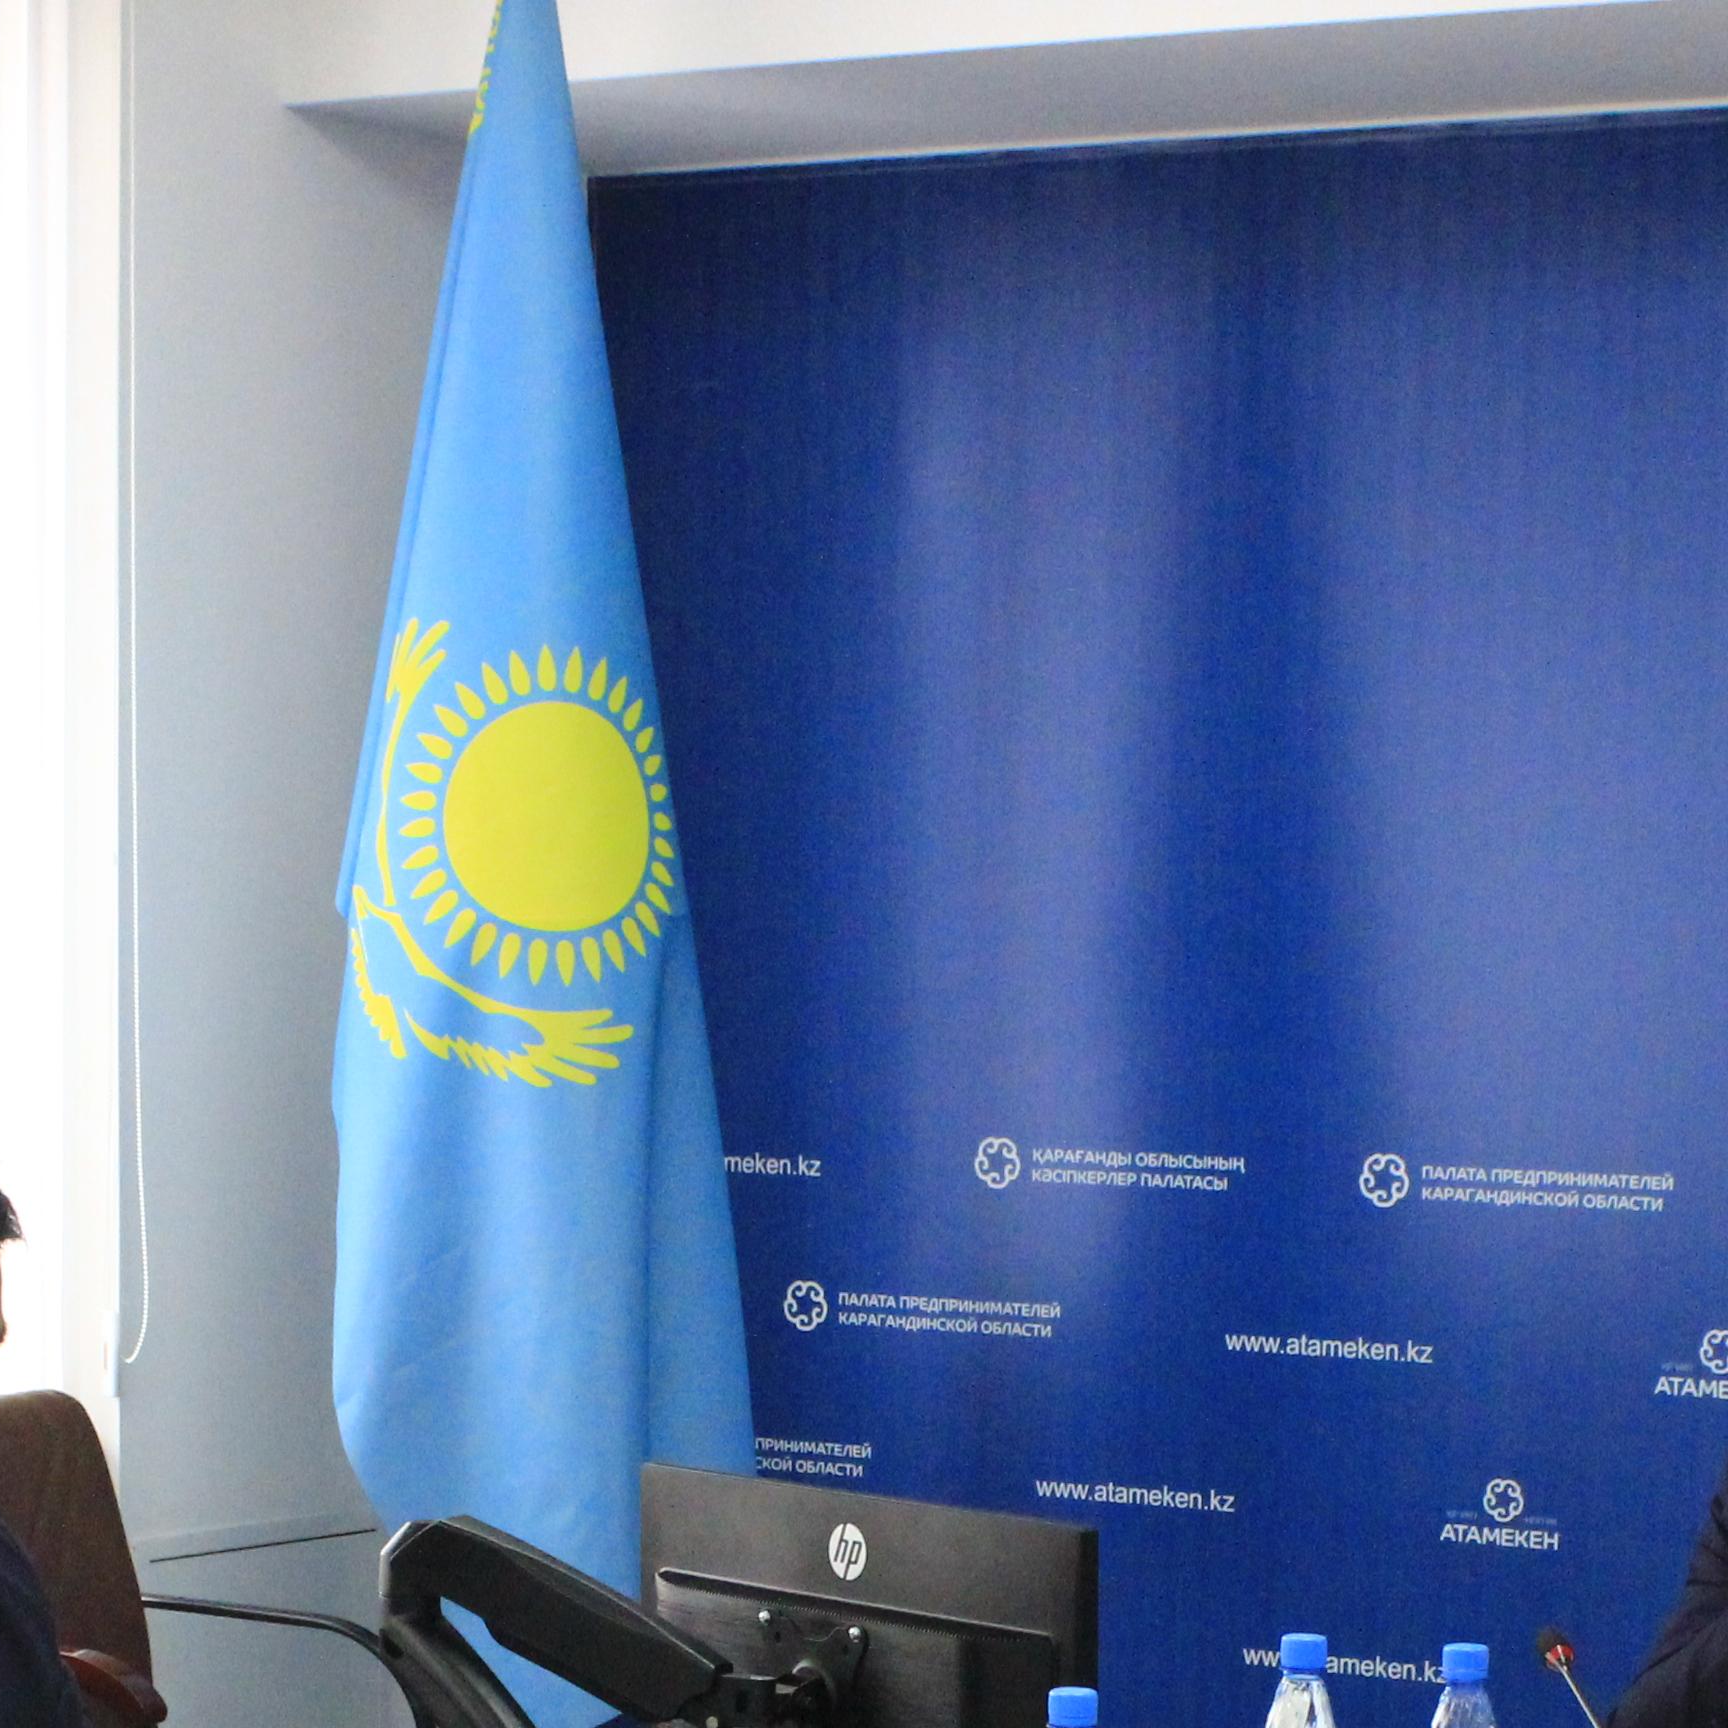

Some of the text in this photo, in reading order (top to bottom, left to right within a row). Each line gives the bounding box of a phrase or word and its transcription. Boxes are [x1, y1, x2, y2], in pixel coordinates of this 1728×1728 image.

[724, 1152, 821, 1177] meken.kz
[1141, 1173, 1229, 1191] ПАЛАТАСЫ
[1422, 1165, 1674, 1191] ПАЛАТА ПРЕДПРИНИМАТЕЛЕЙ
[1422, 1187, 1664, 1212] КАРАГАНДИНСКОЙ ОБЛАСТИ
[838, 1292, 1061, 1318] ПАЛАТА ПРЕДПРИНИМАТЕЛЕЙ
[838, 1312, 1052, 1338] КАРАГАНДИНСКОЙ ОБЛАСТИ
[1225, 1333, 1434, 1363] www.atameken.kz
[755, 1437, 872, 1459] ПРИНИМАТЕЛЕЙ
[756, 1455, 864, 1477] СКОЙ ОБЛАСТИ
[1036, 1480, 1235, 1513] www.atameken.kz
[1440, 1523, 1559, 1550] АТАМЕКЕН
[830, 1524, 866, 1580] hp
